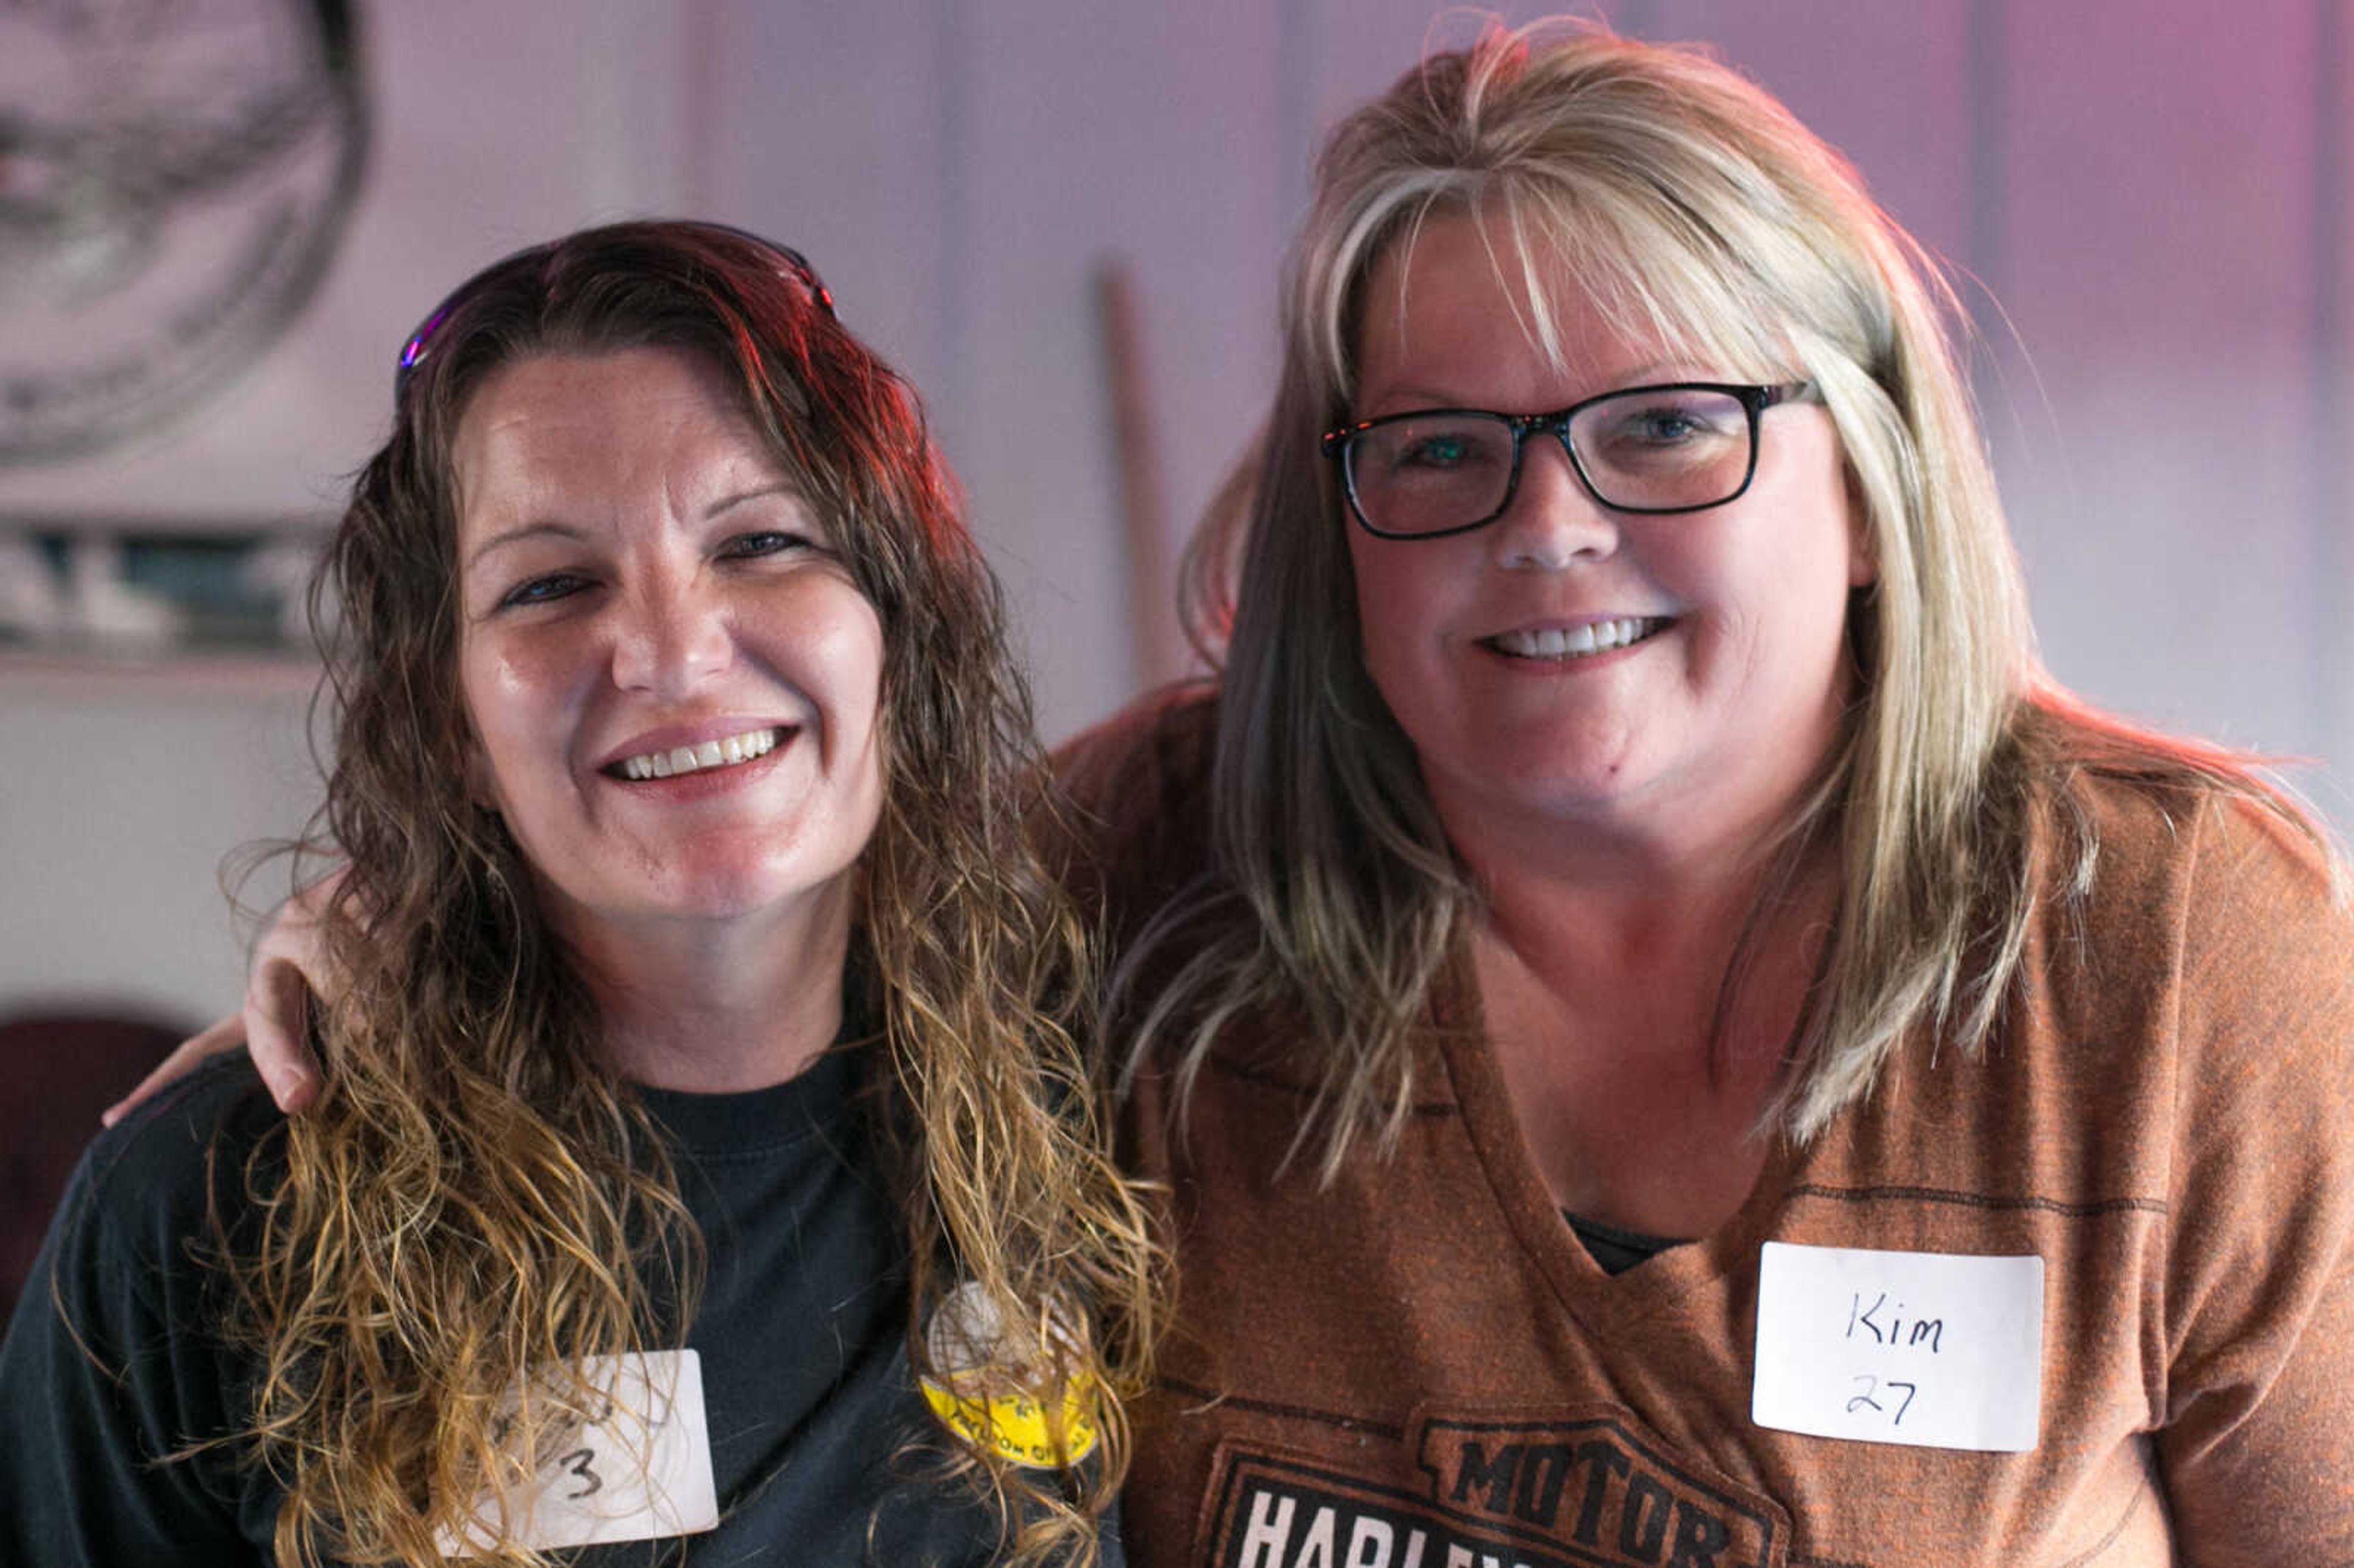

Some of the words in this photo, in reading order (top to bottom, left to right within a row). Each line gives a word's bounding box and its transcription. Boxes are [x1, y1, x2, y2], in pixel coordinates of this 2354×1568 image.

[1846, 1293, 1942, 1353] Kim
[1847, 1374, 1915, 1425] 27
[1238, 1491, 1533, 1568] HAR
[1449, 1442, 1731, 1568] MOTOR
